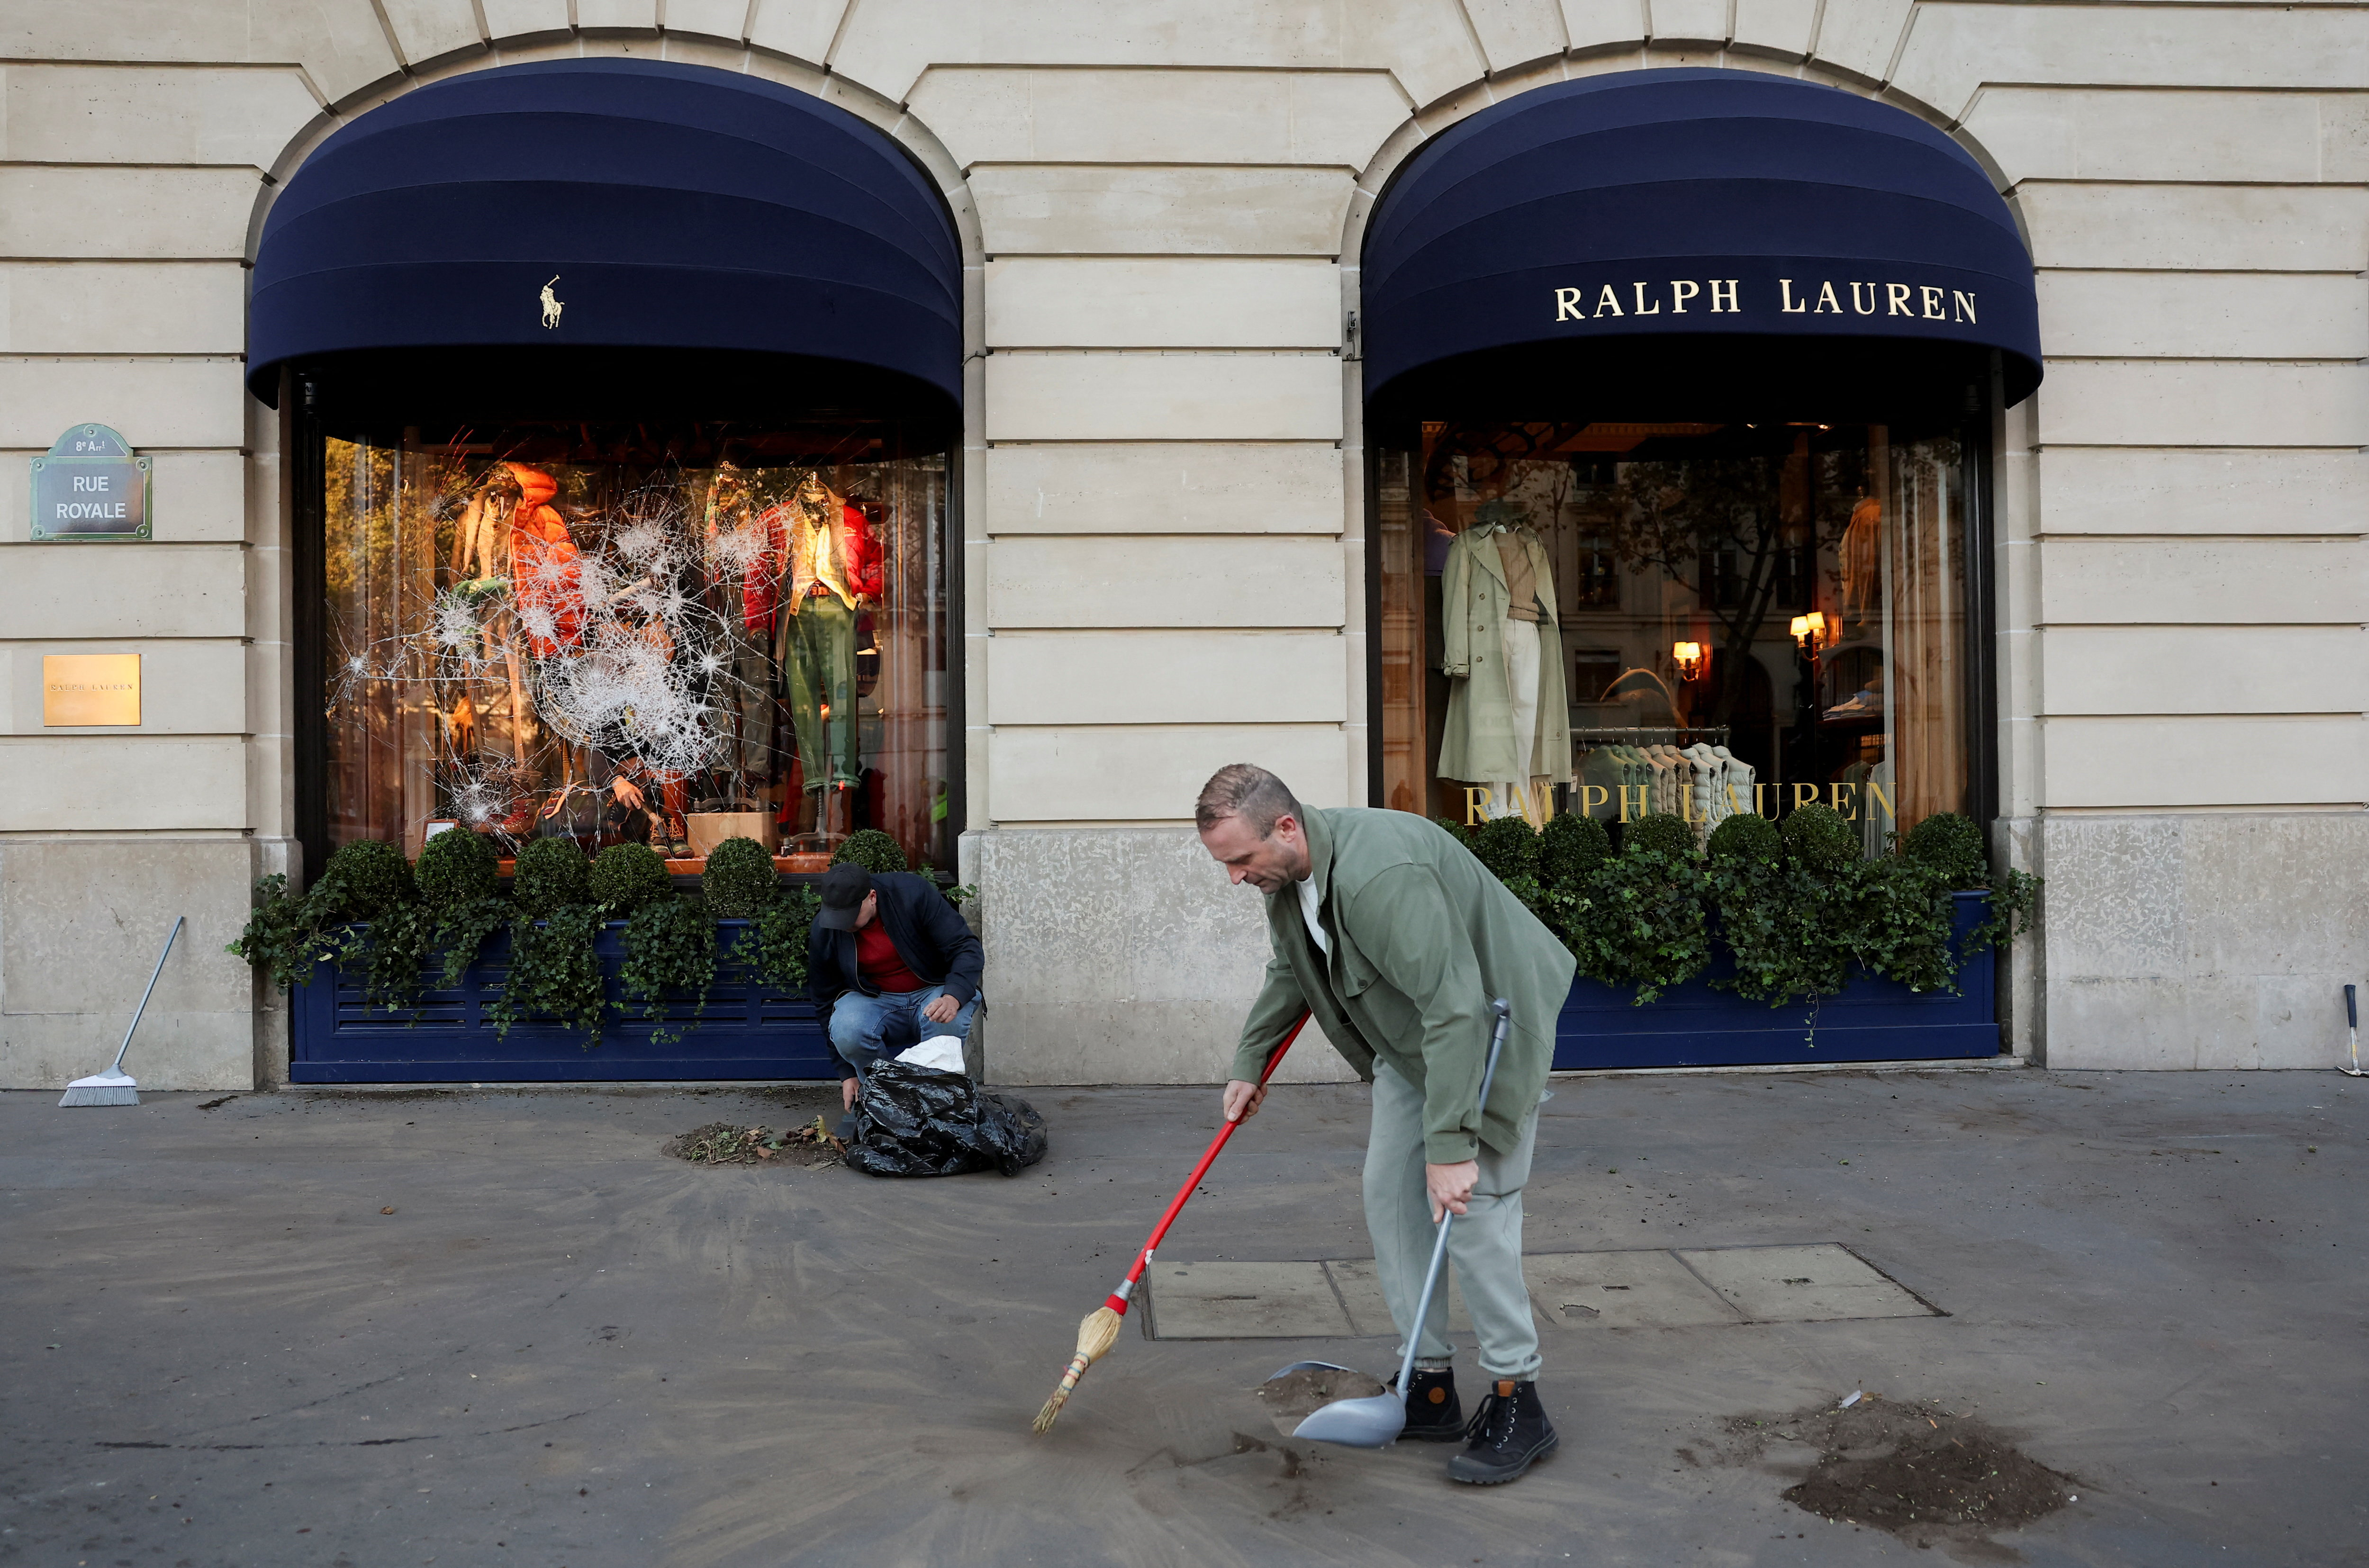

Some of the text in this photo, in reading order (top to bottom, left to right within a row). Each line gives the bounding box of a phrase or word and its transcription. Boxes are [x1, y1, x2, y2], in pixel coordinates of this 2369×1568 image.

[1555, 279, 1976, 324] RALPH LAUREN
[73, 476, 109, 492] RUE
[56, 503, 126, 519] ROYALE
[1464, 783, 1896, 826] RALPH LAUREN
